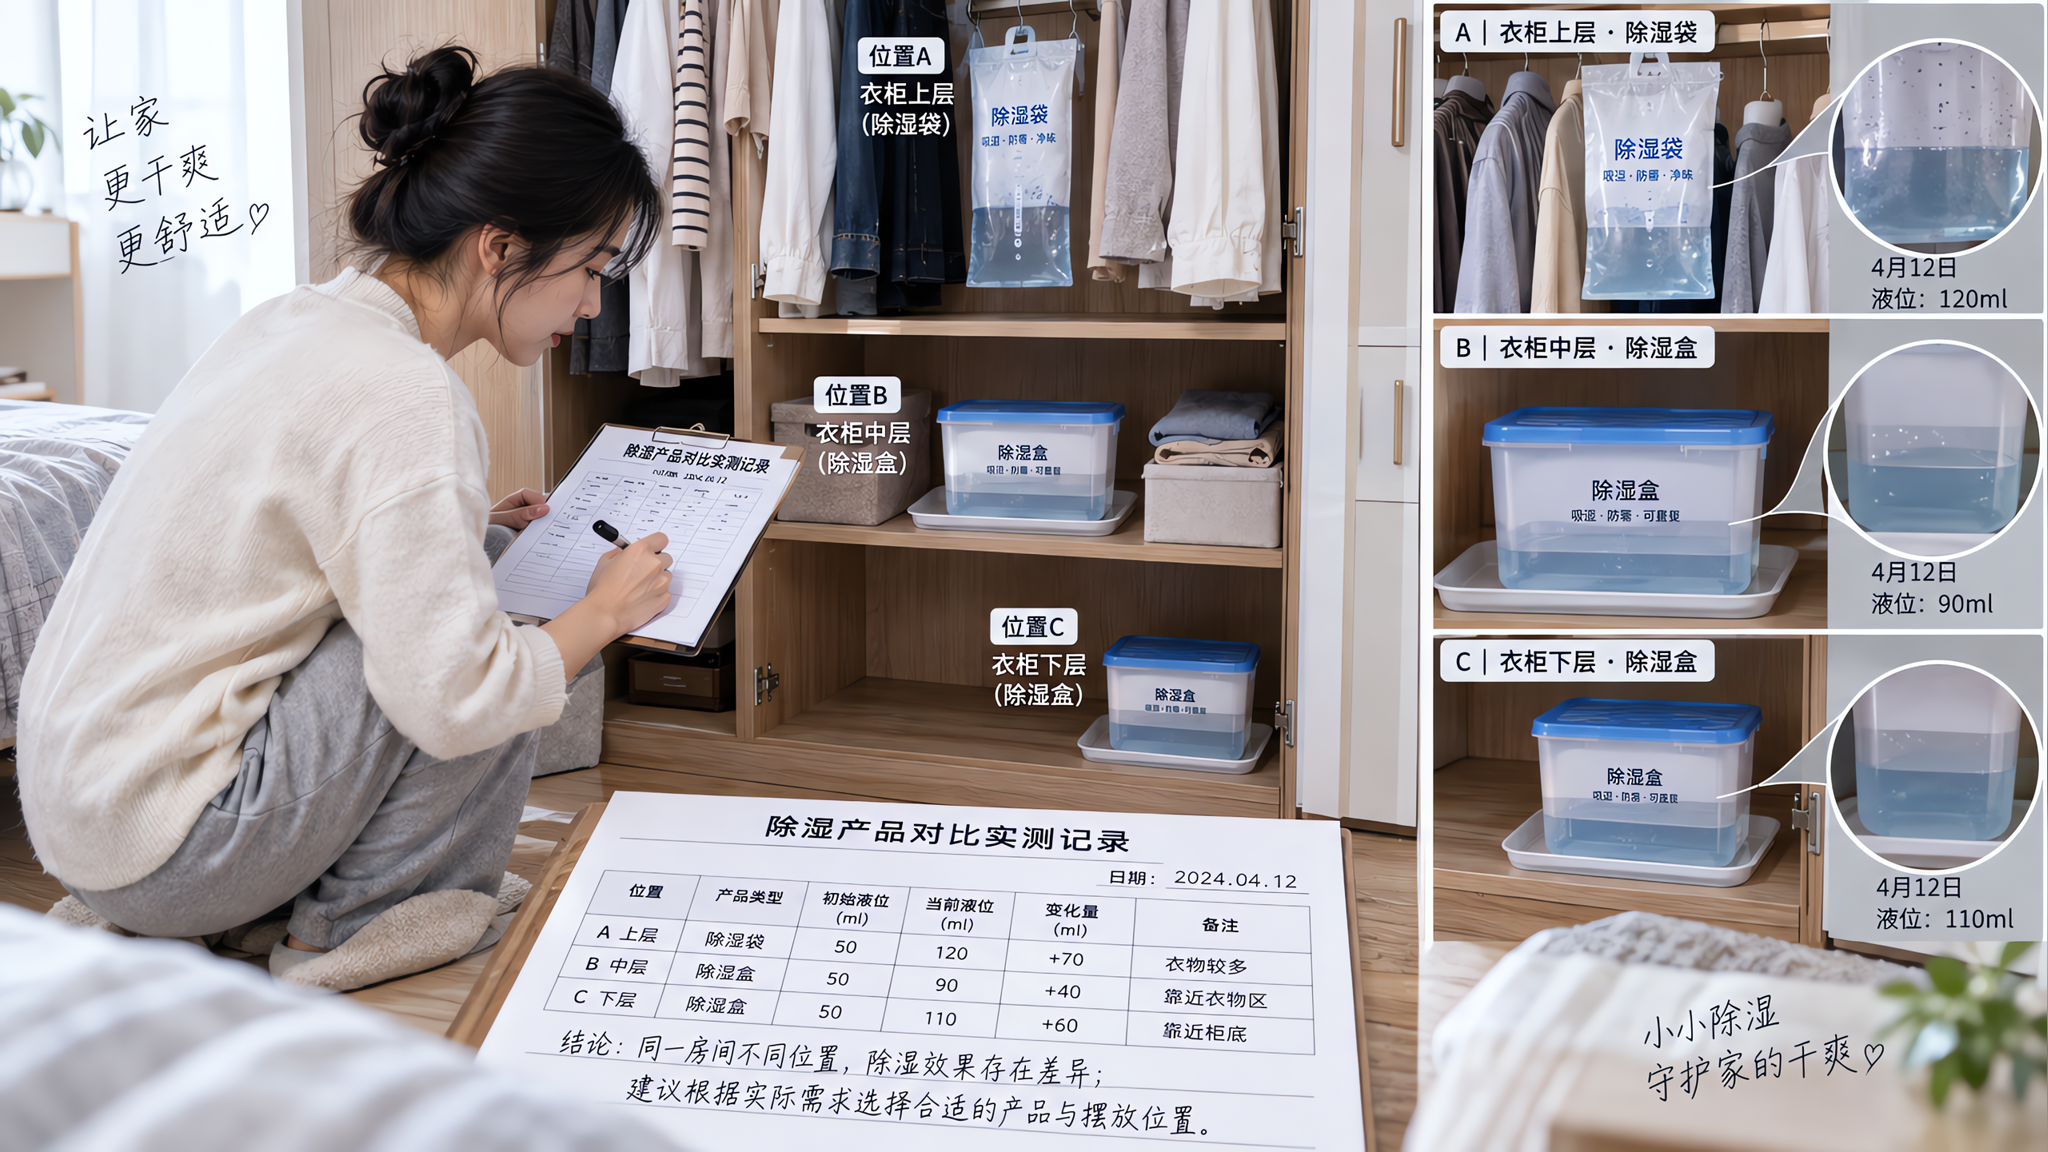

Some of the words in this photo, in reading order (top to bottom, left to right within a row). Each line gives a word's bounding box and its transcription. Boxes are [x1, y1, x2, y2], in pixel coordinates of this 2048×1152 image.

[991, 104, 1048, 127] 除湿袋
[1614, 137, 1683, 161] 除湿袋
[1592, 479, 1660, 501] 除湿盒
[765, 814, 1130, 853] 除湿产品对比实测记录
[1174, 870, 1297, 889] 2024.04.12
[629, 884, 664, 899] 位置
[716, 888, 784, 905] 产品类型
[822, 891, 890, 908] 初始液位
[925, 897, 994, 914] 当前液位
[1045, 903, 1099, 919] 变化量
[836, 911, 869, 927] (ml)
[941, 917, 974, 933] (ml)
[1202, 917, 1239, 933] 备注
[597, 925, 610, 939] A
[619, 926, 659, 943] 上层
[1053, 923, 1087, 938] (ml)
[705, 931, 765, 950] 除湿袋
[834, 940, 857, 954] 50
[935, 946, 969, 960] 120
[1049, 952, 1084, 967] +70
[585, 957, 600, 971] B
[610, 957, 649, 975] 中层
[695, 963, 756, 982] 除湿盒
[1165, 956, 1247, 975] 衣物较多
[826, 972, 849, 986] 50
[935, 978, 959, 992] 90
[574, 989, 588, 1004] C
[599, 990, 637, 1008] 下层
[1045, 985, 1081, 999] +40
[685, 996, 748, 1015] 除湿盒
[819, 1004, 842, 1019] 50
[925, 1011, 957, 1027] 110
[1042, 1018, 1078, 1033] +60
[626, 1074, 1208, 1136] 建议根据实际需求选择合适的产品与摆放位置。
